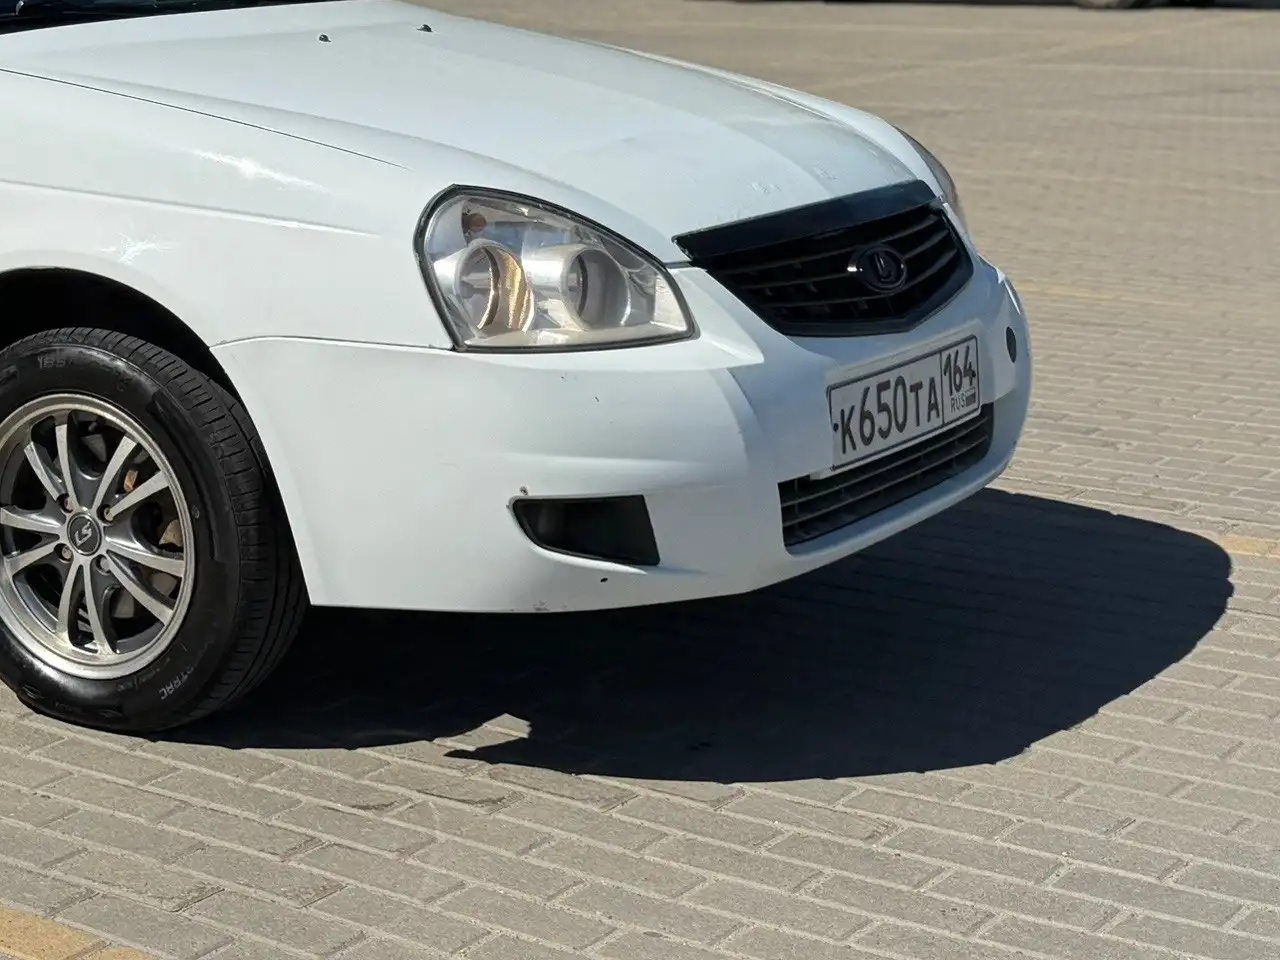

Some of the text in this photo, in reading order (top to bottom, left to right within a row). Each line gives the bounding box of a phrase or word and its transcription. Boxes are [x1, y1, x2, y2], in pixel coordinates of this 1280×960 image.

[839, 345, 977, 455] К650ТА 164
[950, 393, 967, 413] RUS
